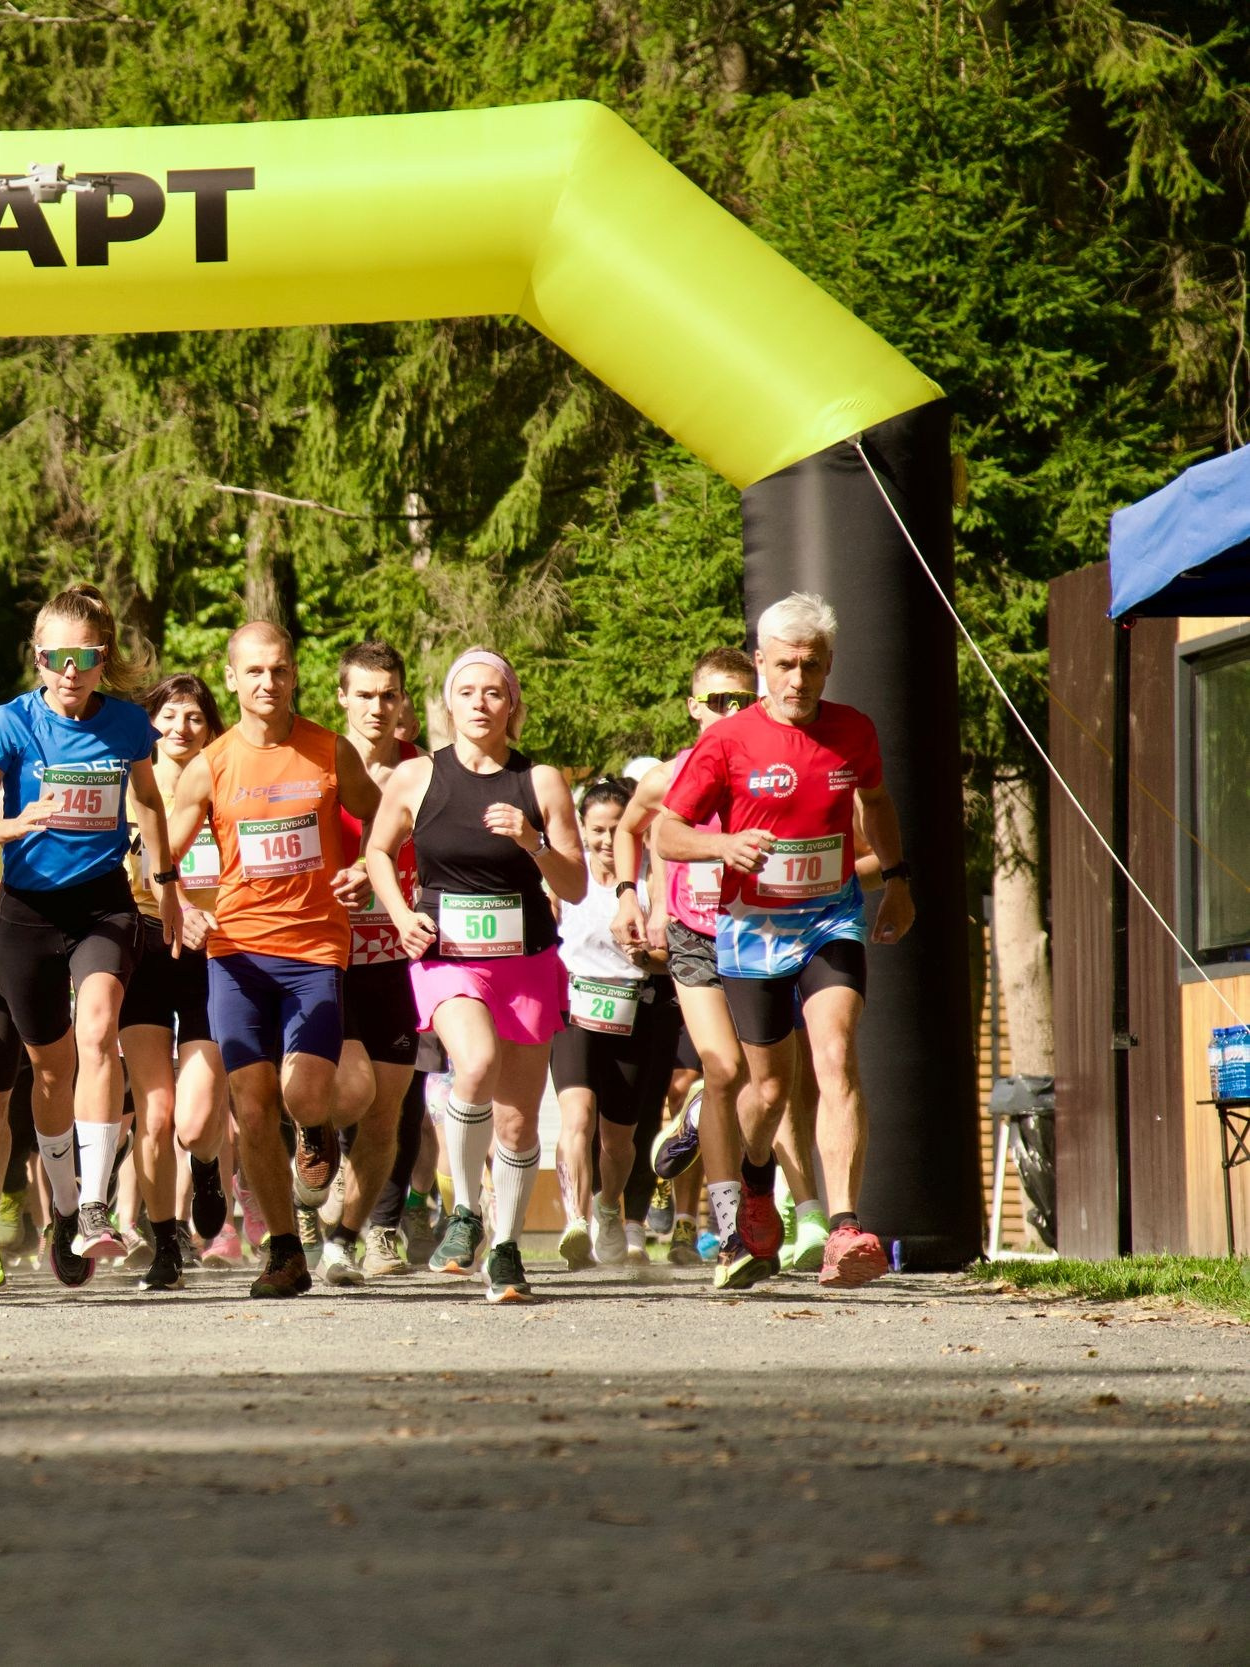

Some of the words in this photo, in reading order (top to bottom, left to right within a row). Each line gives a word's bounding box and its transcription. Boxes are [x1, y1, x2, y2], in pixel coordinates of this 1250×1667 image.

[52, 773, 85, 782] КРОСС
[86, 775, 115, 784] ДУБКИ
[749, 774, 791, 789] БЕГИ
[61, 788, 103, 814] 145
[246, 823, 279, 833] КРОСС
[280, 818, 310, 831] ДУБКИ
[260, 833, 302, 861] 146
[805, 840, 835, 852] ДУБКИ
[783, 856, 821, 882] 170
[449, 900, 481, 908] КРОСС
[482, 899, 514, 909] ДУБКИ
[465, 914, 497, 940] 50
[579, 983, 607, 995] КРОСС
[607, 988, 634, 999] ДУБКИ
[590, 997, 616, 1020] 28
